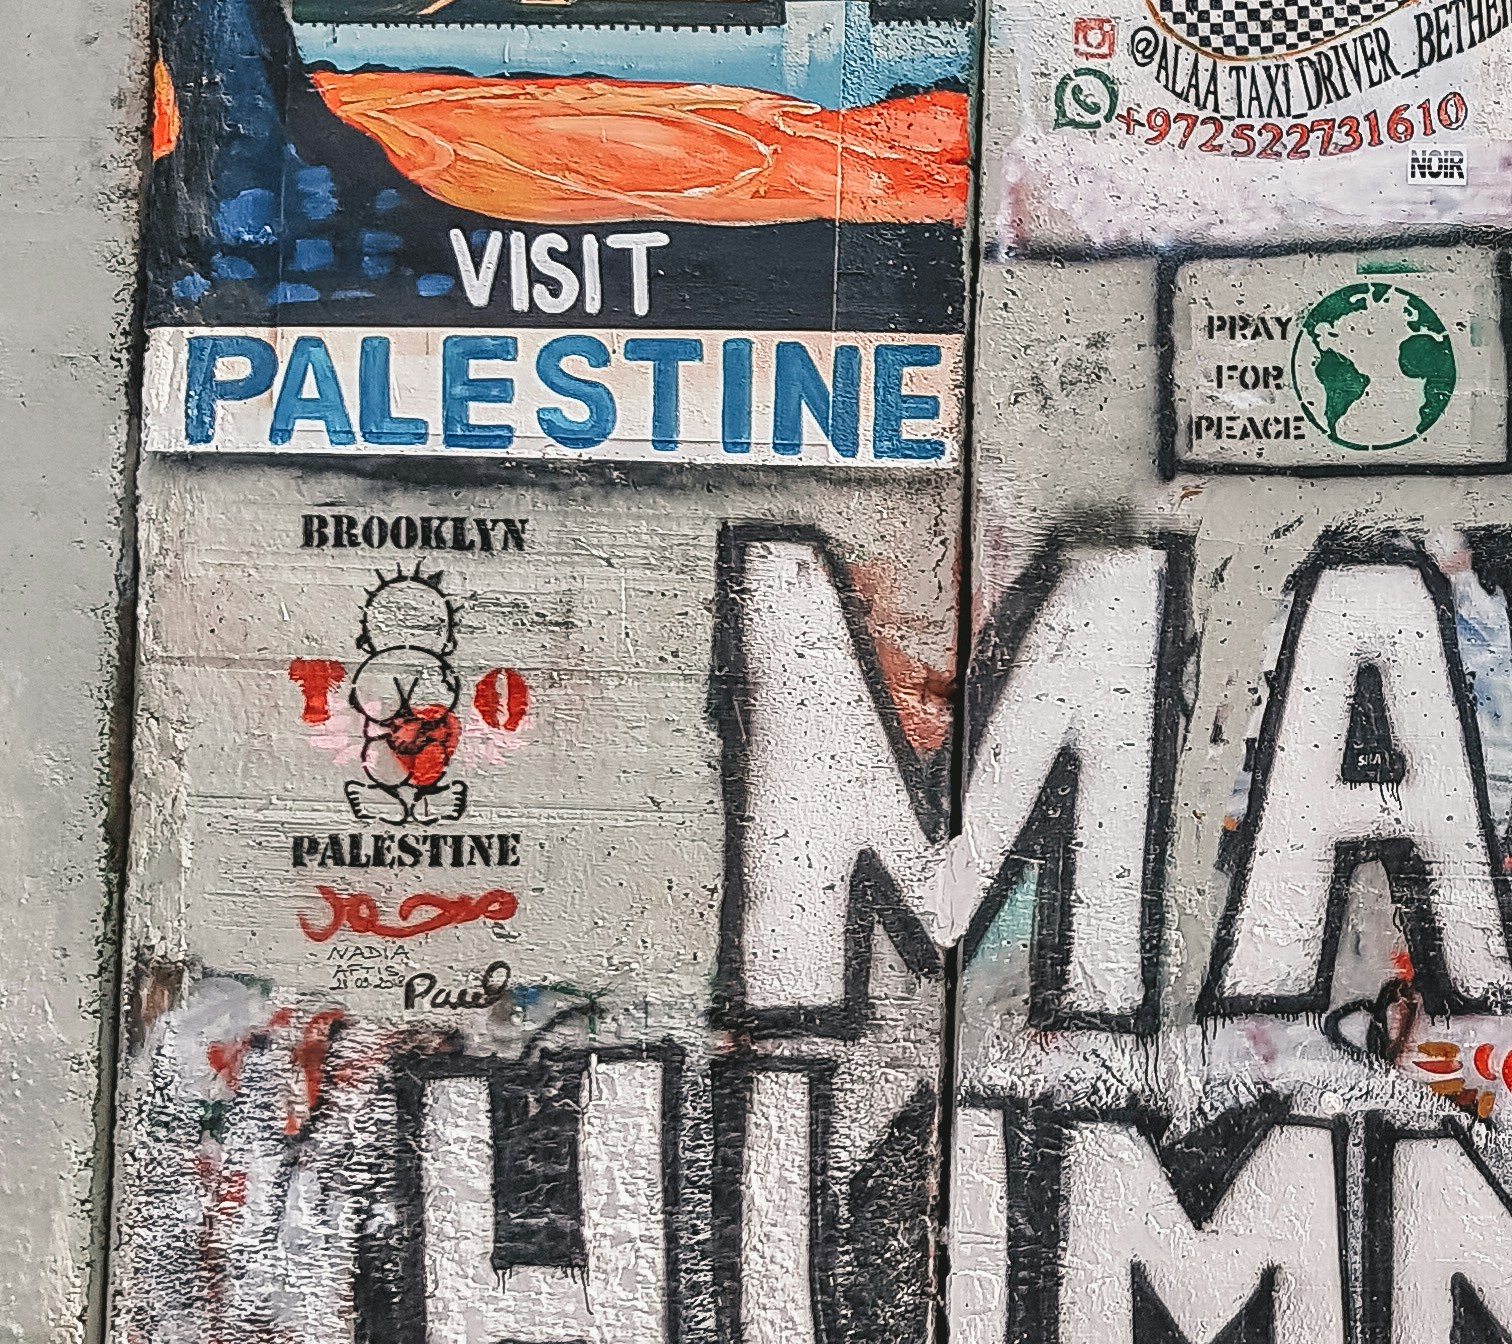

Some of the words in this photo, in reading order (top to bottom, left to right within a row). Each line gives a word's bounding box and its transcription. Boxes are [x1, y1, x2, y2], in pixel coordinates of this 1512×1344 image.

[1410, 149, 1465, 180] NOIR
[449, 228, 670, 317] VISIT
[1206, 315, 1293, 341] PRAY
[1215, 364, 1284, 390] FOR
[184, 335, 947, 461] PALESTINE
[1194, 415, 1306, 441] PEACE
[300, 514, 529, 552] BROOKLYN
[291, 832, 521, 869] PALESTINE
